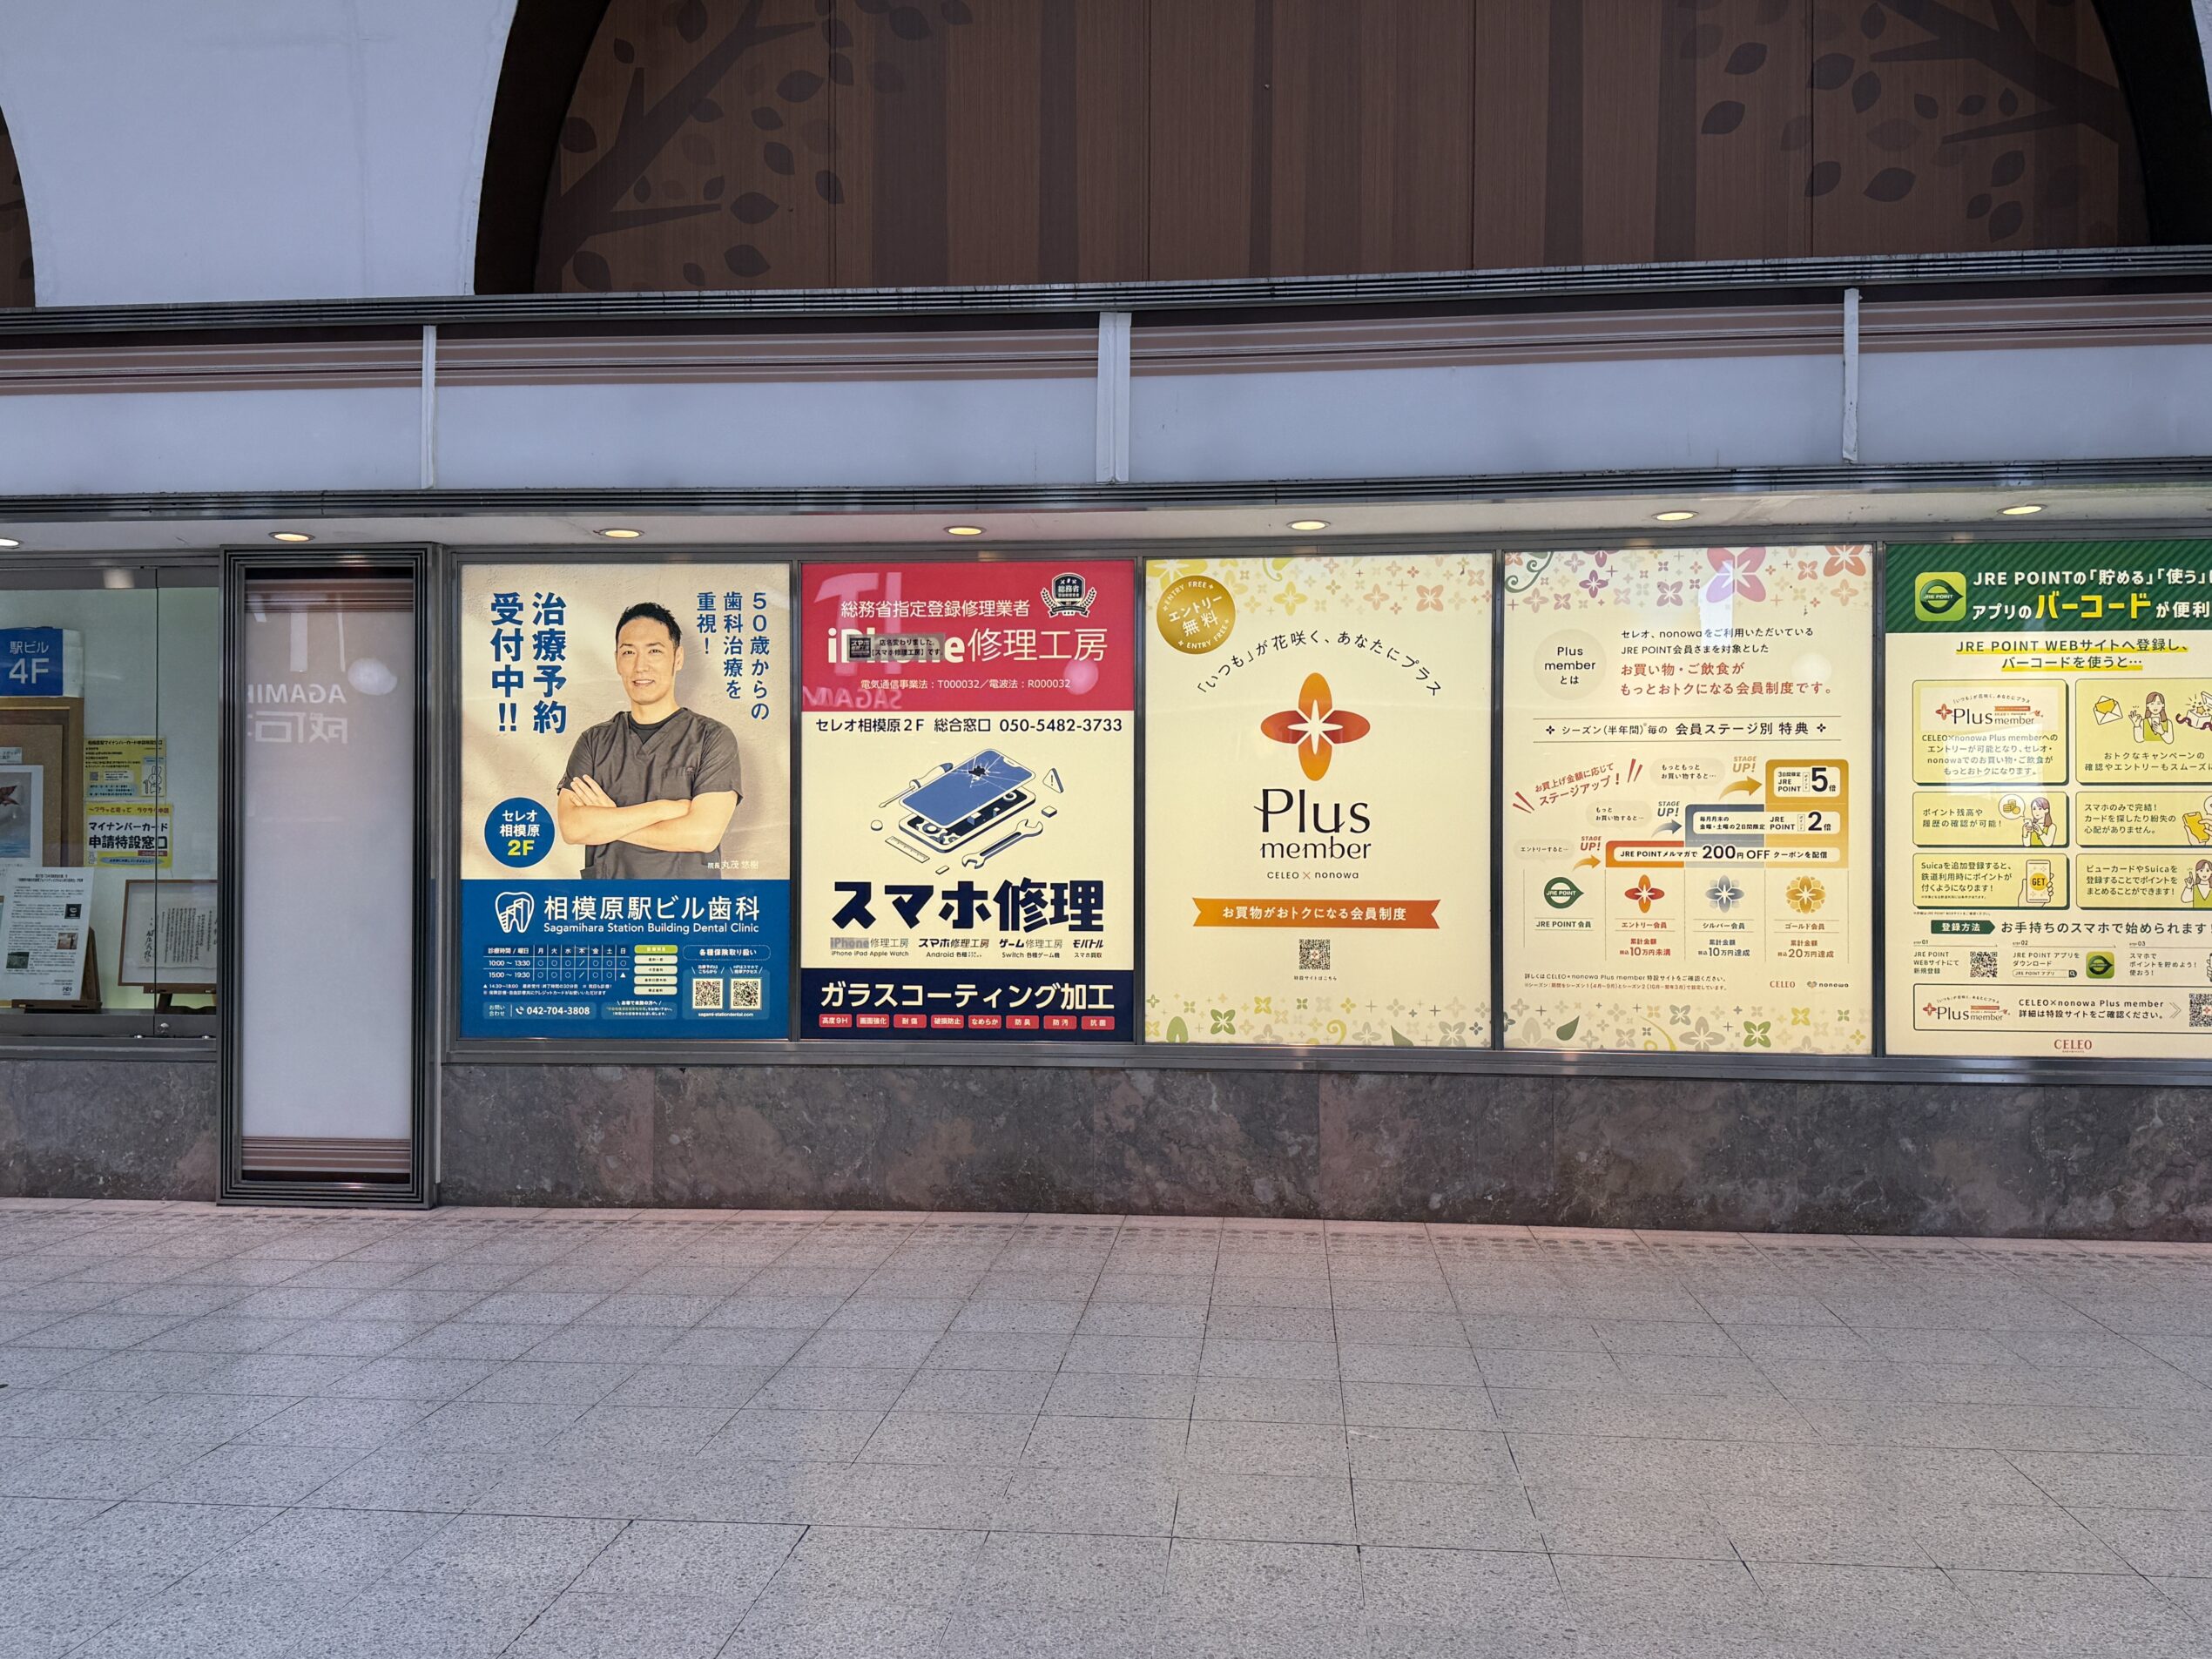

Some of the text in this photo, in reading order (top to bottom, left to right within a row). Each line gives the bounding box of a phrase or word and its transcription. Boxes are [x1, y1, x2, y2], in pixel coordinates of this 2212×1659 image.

[1973, 568, 2212, 586] JRE POINTの「貯める」「使う」
[1164, 583, 1185, 605] ENTRY
[840, 599, 1031, 618] 総務省指定登録修理業者
[1169, 596, 1223, 623] エントリー
[697, 591, 717, 655] 重視！
[1183, 610, 1218, 637] 無料
[1186, 624, 1228, 649] ENTRY FREE
[10, 641, 50, 654] 駅ビル
[723, 591, 744, 699] 歯科治療を
[1556, 646, 1583, 657] Plus
[1621, 645, 1639, 655] JRE
[1956, 638, 2188, 652] JRE POINT WEBサイトへ登録し、
[532, 591, 567, 734] 治療予約
[750, 591, 771, 720] 50歳からの
[1197, 630, 1442, 696] 「いつも」が花咲く、あなたにプラス
[1544, 659, 1596, 671] member
[1621, 662, 1745, 677] お買い物・ご飲食が
[9, 658, 50, 685] 4F
[1560, 675, 1580, 685] とは
[1621, 681, 1831, 696] もっとおトクになる会員制度です。
[1951, 708, 2034, 725] Plus member
[934, 718, 991, 732] 総合窓口
[1000, 719, 1123, 732] 050-5482-3733
[1676, 722, 1773, 736] 会員ステージ別
[1779, 721, 1809, 735] 特典
[1733, 763, 1756, 772] UP!
[1534, 762, 1615, 792] お買上げ金額に応じて
[502, 809, 538, 822] セレオ
[1253, 788, 1371, 833] Plus
[1657, 806, 1680, 817] UP!
[1922, 808, 1983, 817] ポイント残高や
[2084, 814, 2176, 823] カードを探したり紛失の
[89, 821, 168, 832] マイナンバーカード
[499, 823, 540, 838] 相模原
[2084, 826, 2155, 834] 心配がありません。
[89, 834, 168, 850] 申請特設窓口
[507, 840, 535, 856] 2F
[1259, 836, 1372, 860] member
[1580, 841, 1601, 851] UP!
[1746, 850, 1770, 859] OFF
[1266, 871, 1359, 880] CELEO nonowa
[2032, 878, 2046, 887] GET
[2086, 876, 2178, 885] 登録することでポイントを
[543, 895, 760, 921] 相模原駅ビル歯科
[832, 877, 1103, 933] スマホ修理
[1222, 905, 1407, 921] お買物がおトクになる会員制度
[543, 923, 759, 934] Sagamihara Station Building Dental Clinic
[1941, 922, 1980, 932] 登録方法
[918, 938, 990, 948] スマホ修理工房
[999, 938, 1062, 949] ゲーム修理工房
[820, 981, 1115, 1010] ガラスコーティング加工
[526, 1007, 590, 1015] 042-704-3808
[1935, 1007, 1970, 1021] Plus
[2019, 1010, 2163, 1019] 詳細は特設サイトをご確認ください。
[2054, 1039, 2093, 1050] CELEO
